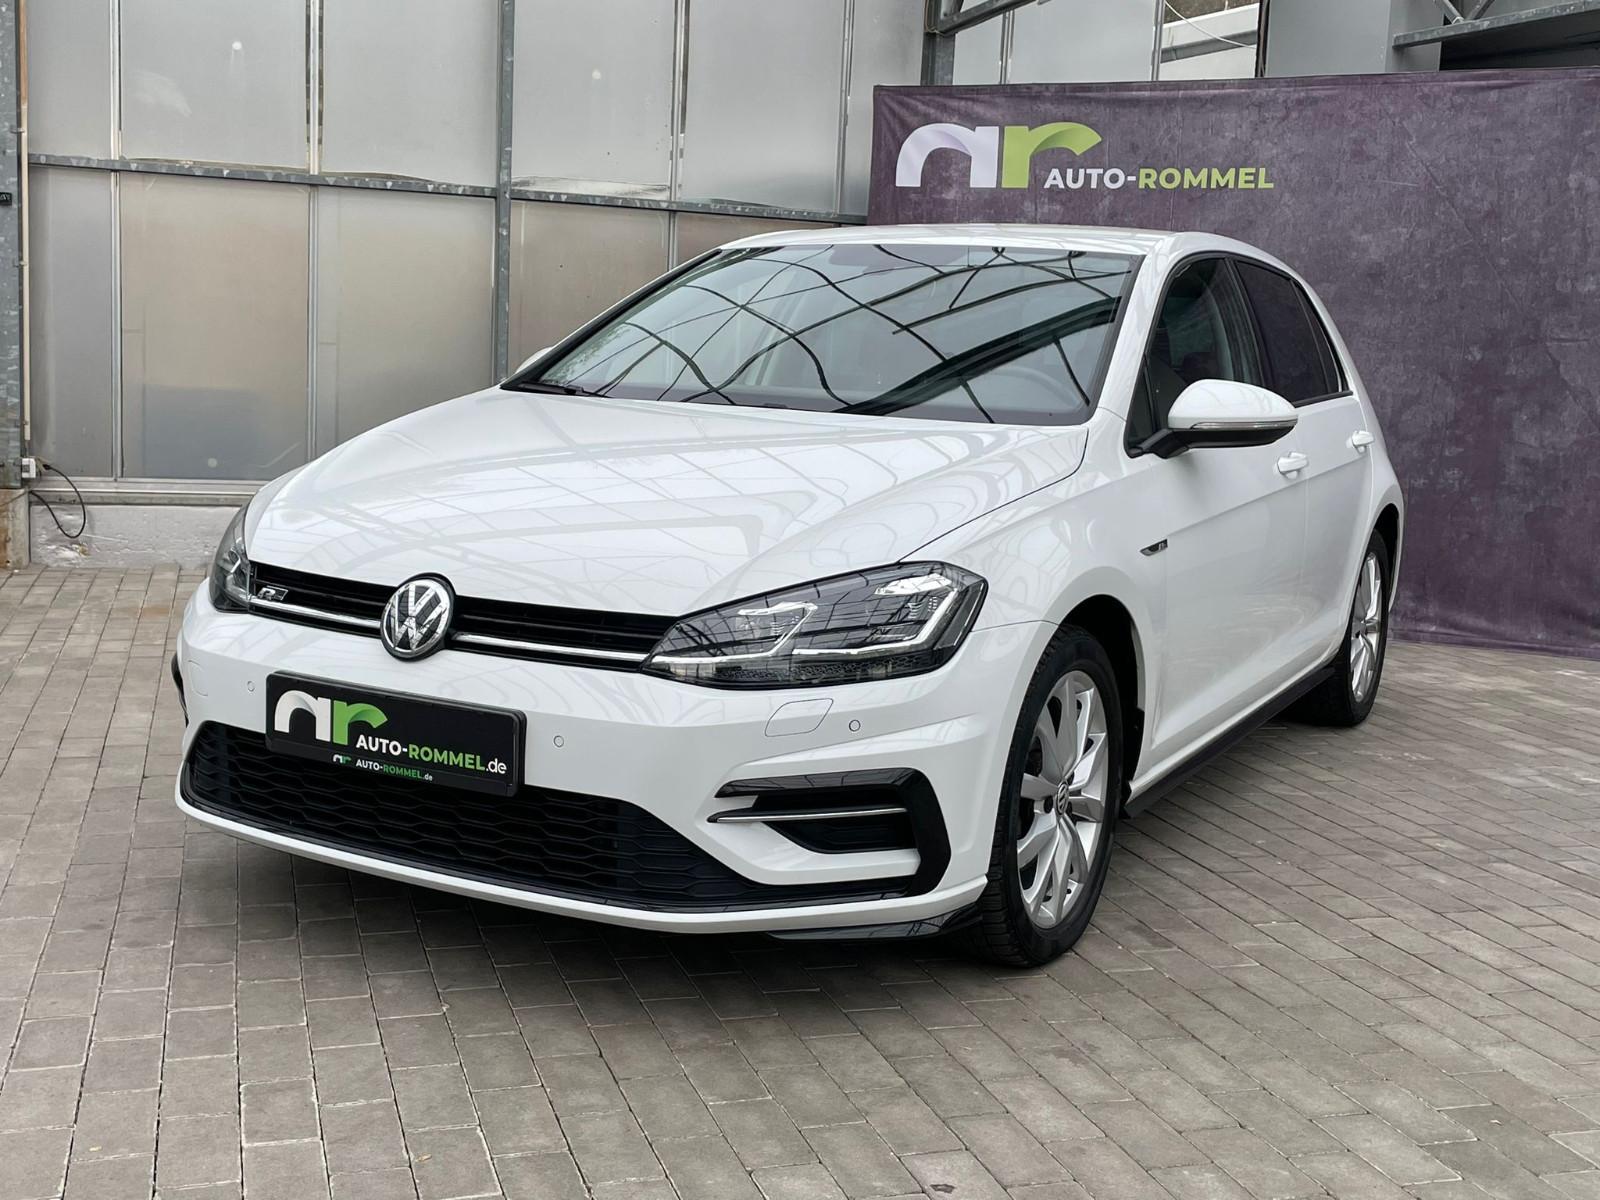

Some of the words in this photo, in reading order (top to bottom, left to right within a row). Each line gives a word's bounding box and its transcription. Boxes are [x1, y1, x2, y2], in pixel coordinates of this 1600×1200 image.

[1043, 167, 1274, 190] AUTO-ROMMEL
[355, 734, 507, 774] AUTO-ROMMEL.de
[355, 758, 433, 782] AUTO-ROMMEL.de
